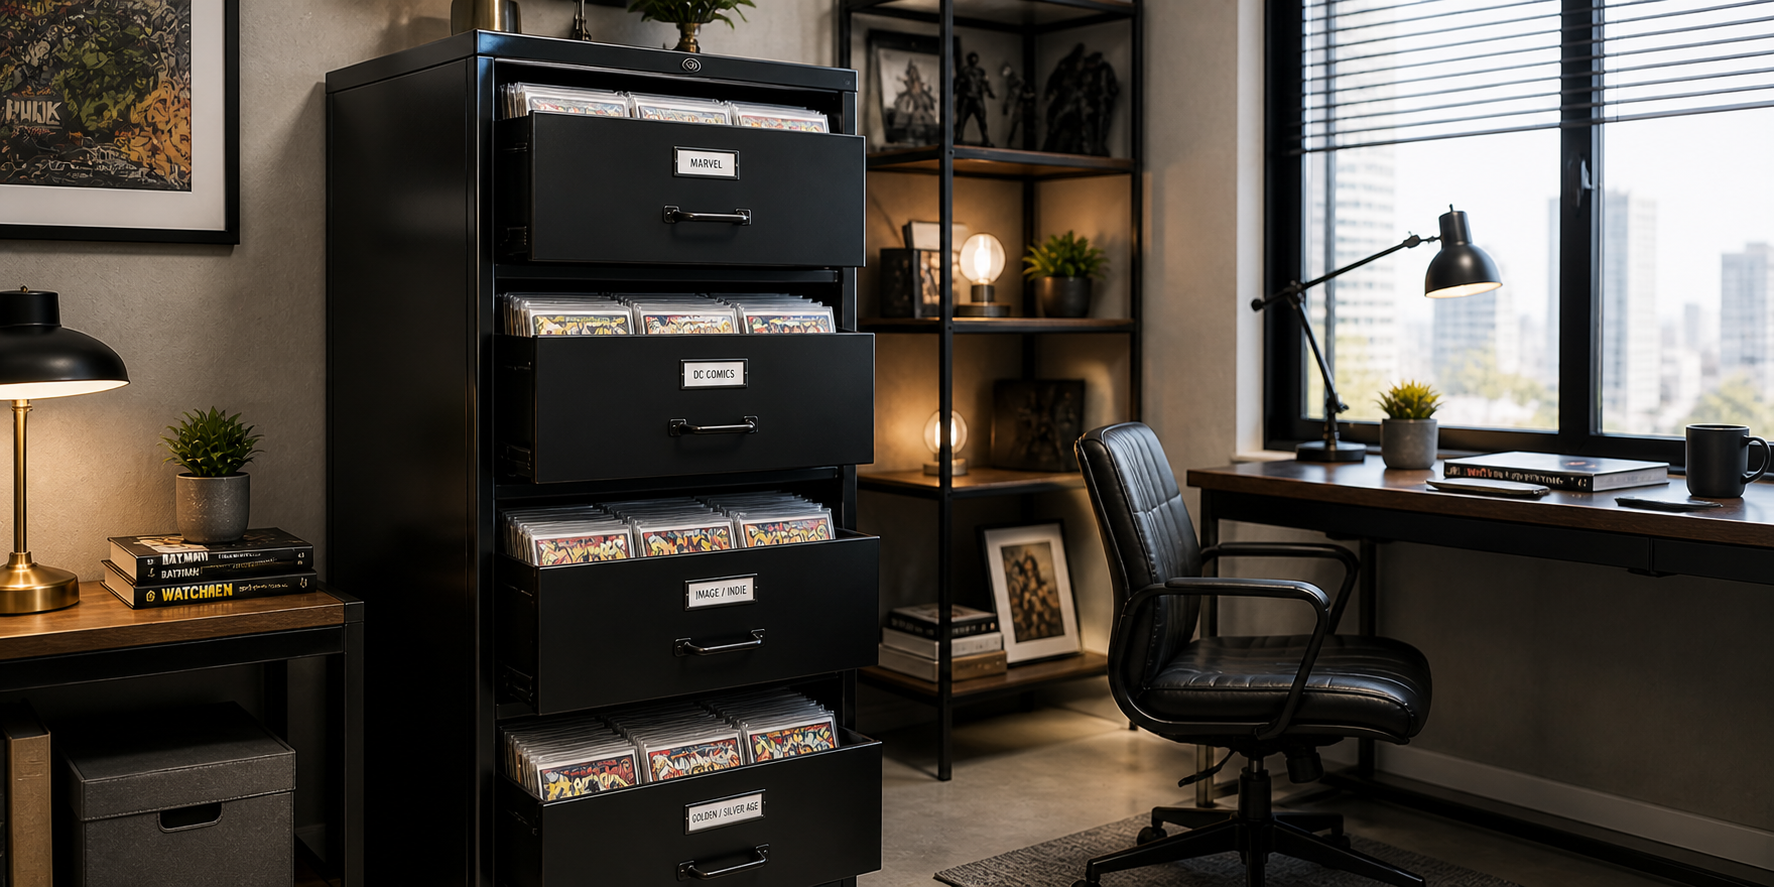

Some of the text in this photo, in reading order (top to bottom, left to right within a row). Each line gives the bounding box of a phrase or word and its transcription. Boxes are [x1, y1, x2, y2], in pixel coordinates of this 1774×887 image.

[690, 158, 723, 169] MARVEL
[693, 369, 735, 380] DC COMICS
[695, 584, 747, 600] IMAGE / INDIE
[692, 809, 718, 823] GOLDEN
[723, 804, 745, 817] SILVER
[746, 801, 759, 811] AGE
